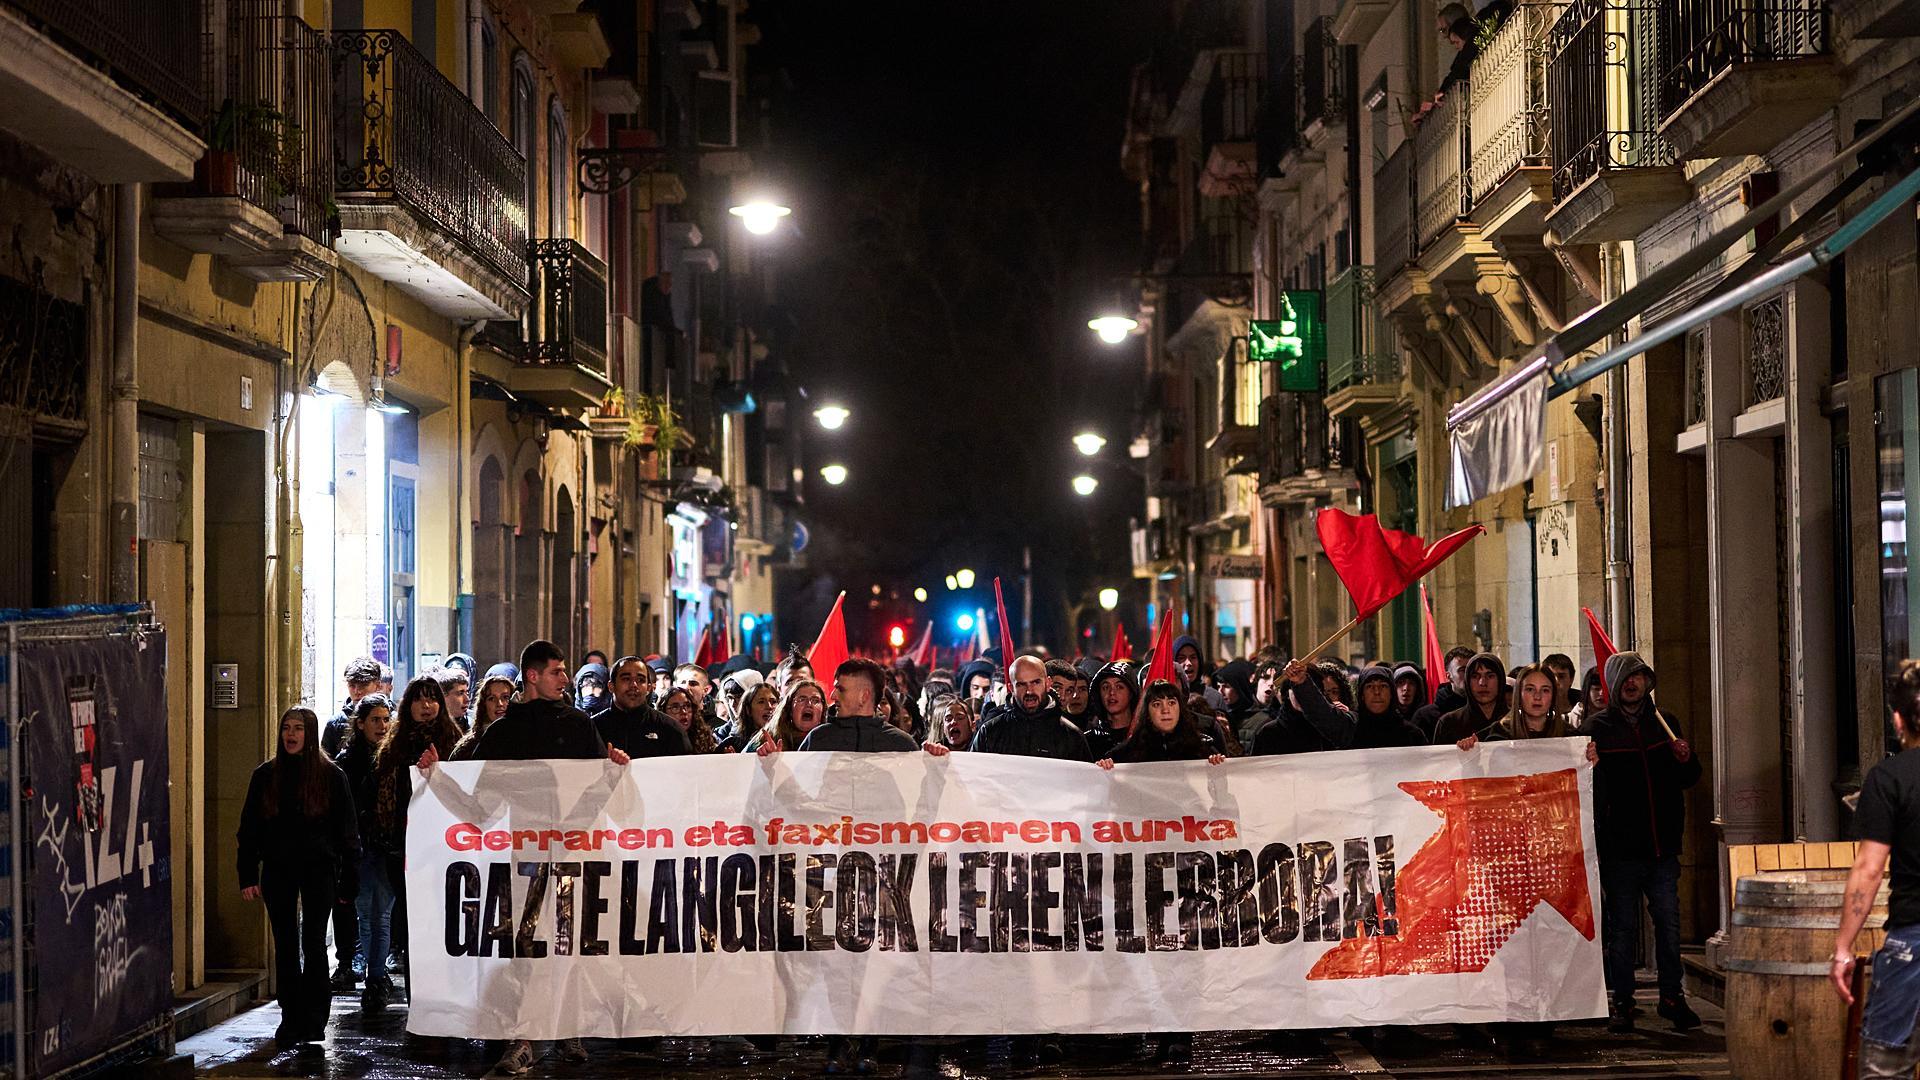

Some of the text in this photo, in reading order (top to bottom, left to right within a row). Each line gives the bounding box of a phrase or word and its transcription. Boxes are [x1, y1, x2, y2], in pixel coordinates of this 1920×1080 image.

[445, 815, 1237, 851] Gerraren eta faxismoaren aurka
[444, 834, 1399, 958] GAZTE LANGILEOK LEHEN LERRORA!
